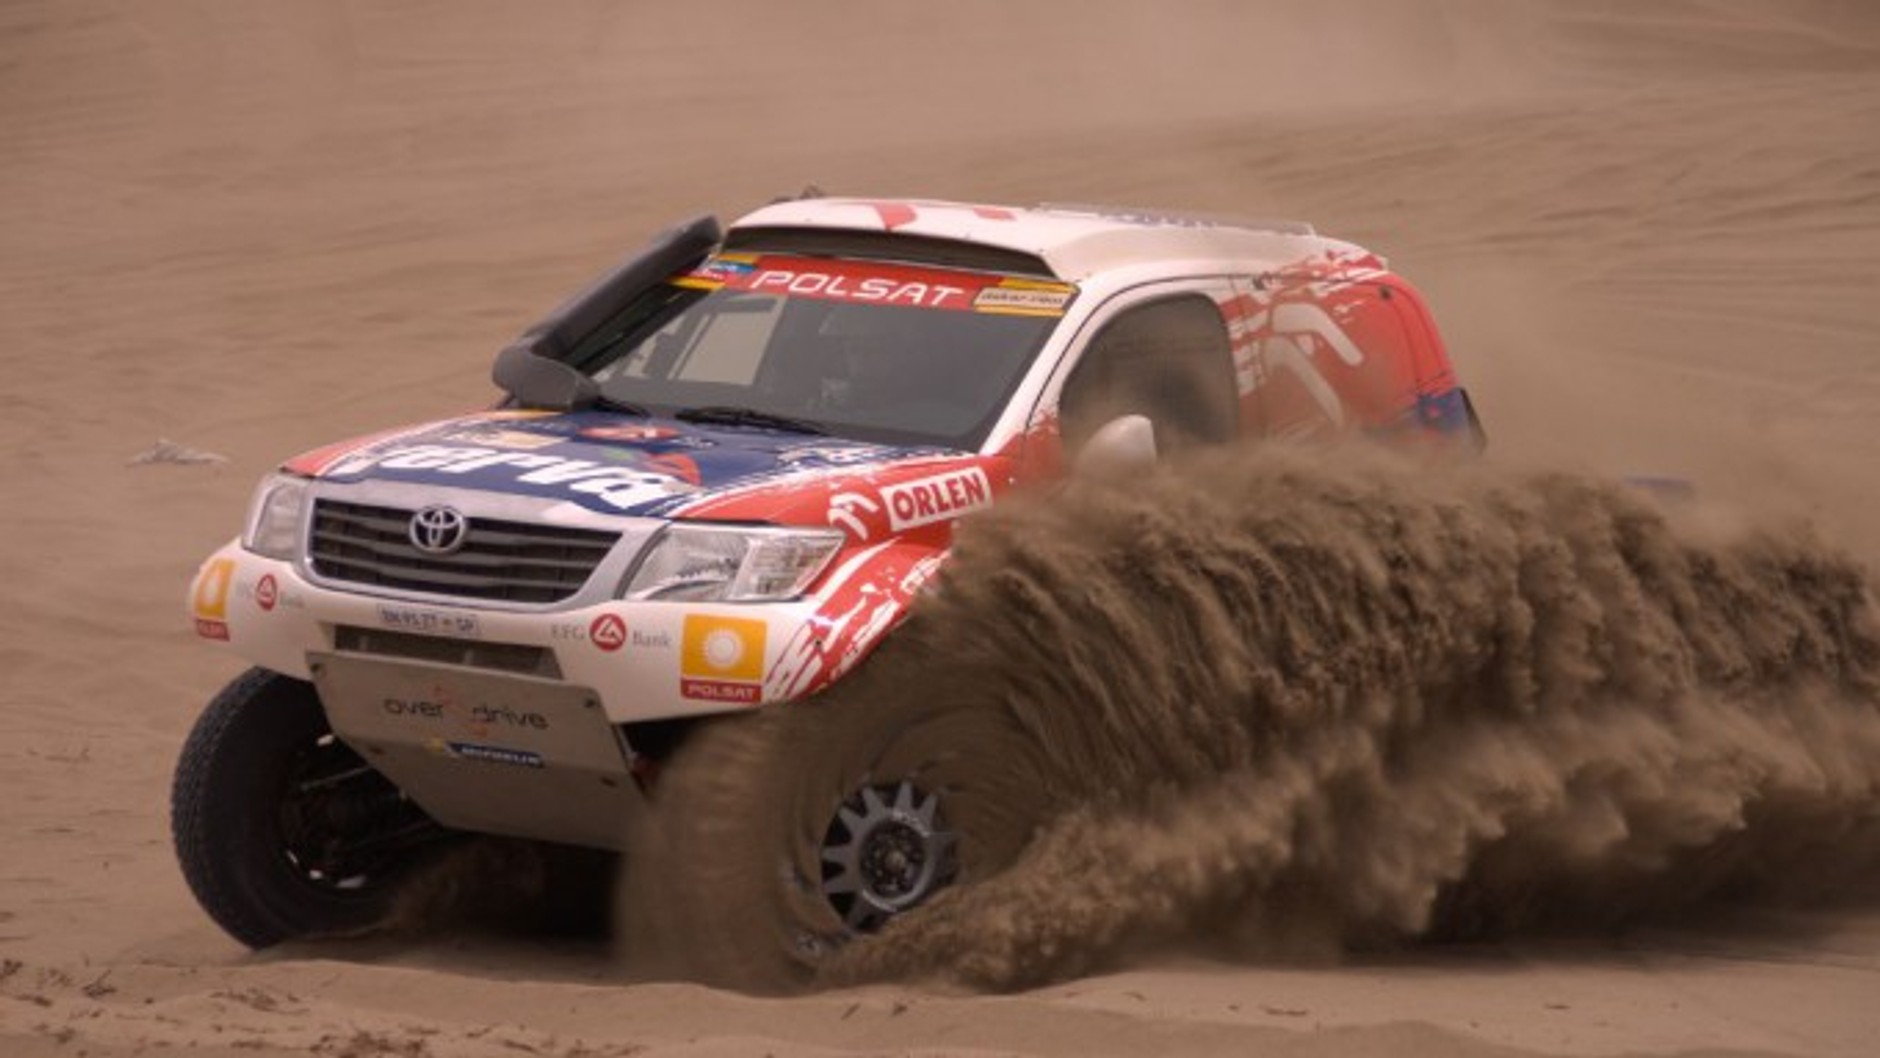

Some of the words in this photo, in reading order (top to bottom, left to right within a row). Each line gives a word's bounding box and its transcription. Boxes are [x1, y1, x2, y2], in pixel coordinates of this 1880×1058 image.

[750, 270, 965, 307] POLSAT
[891, 471, 986, 521] ORLEN
[550, 624, 586, 641] EFG
[632, 629, 671, 648] Bank
[686, 682, 756, 700] POLSAT
